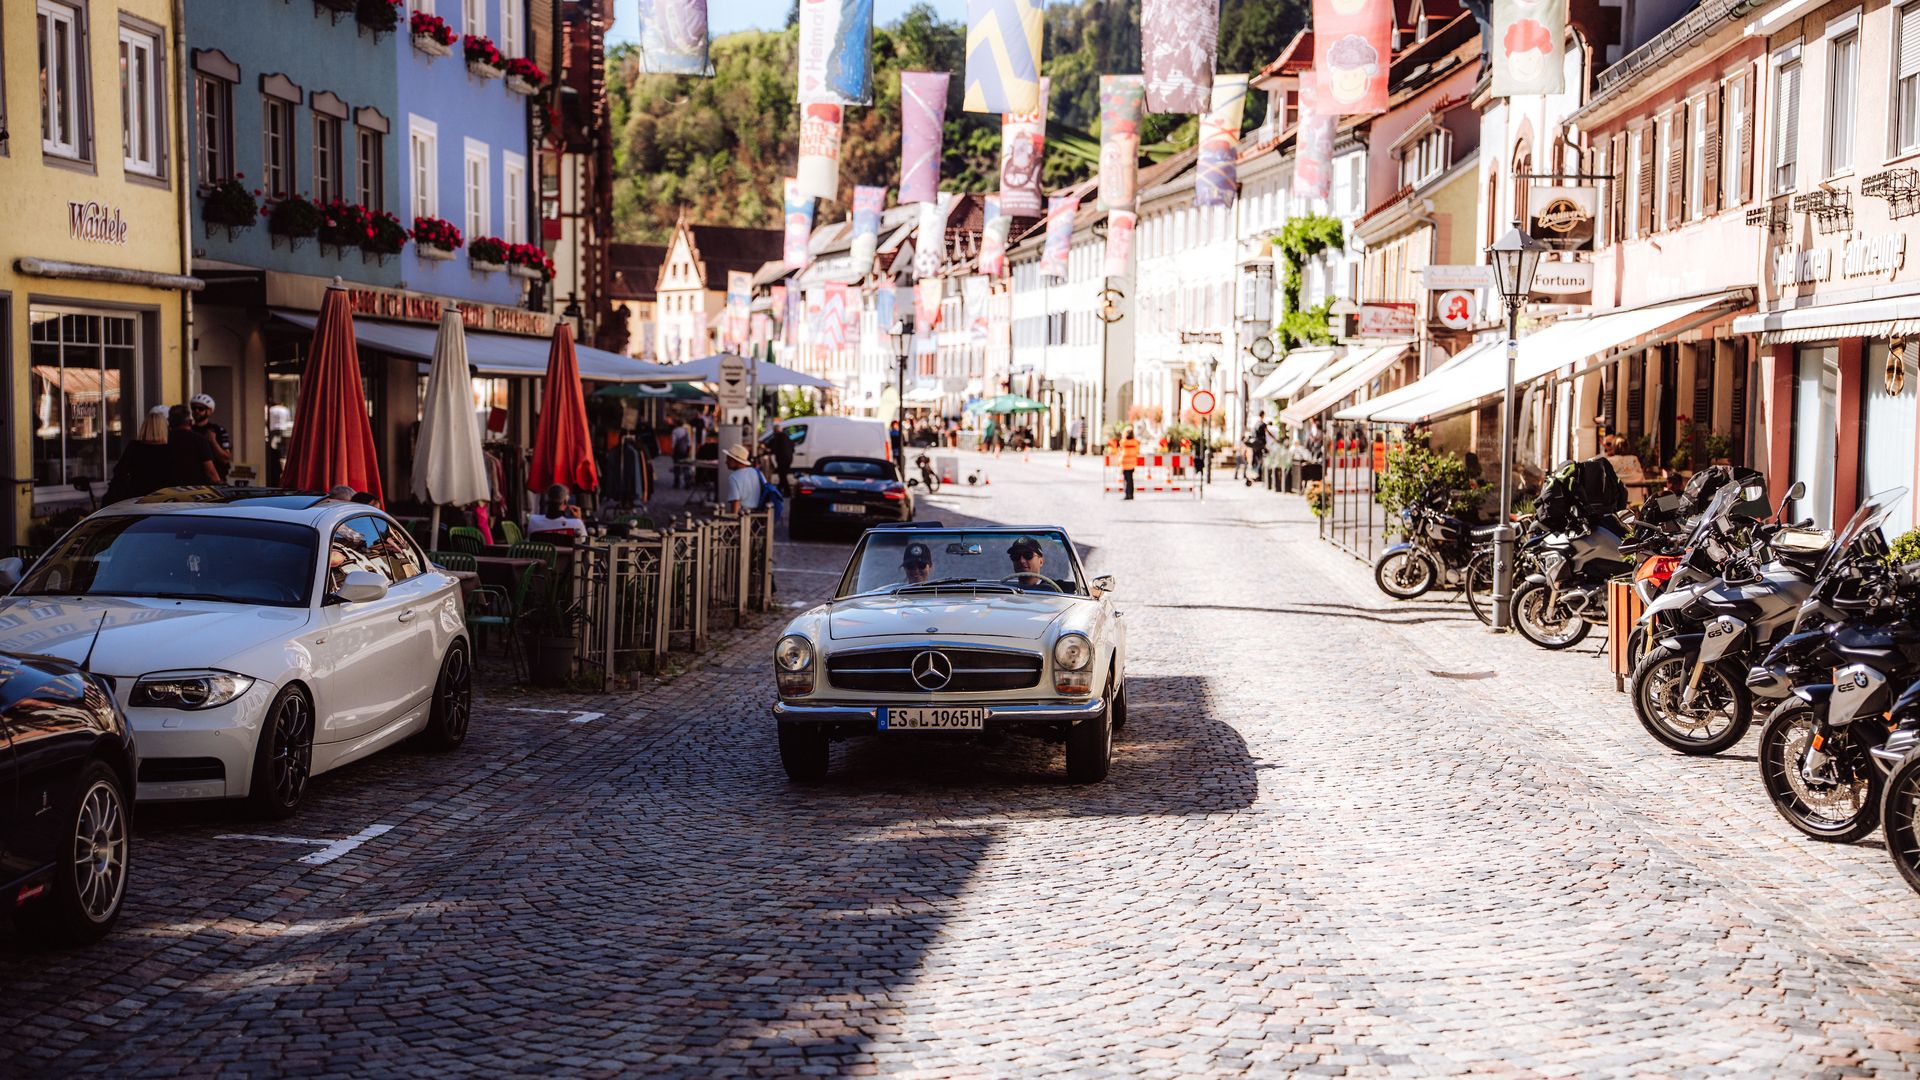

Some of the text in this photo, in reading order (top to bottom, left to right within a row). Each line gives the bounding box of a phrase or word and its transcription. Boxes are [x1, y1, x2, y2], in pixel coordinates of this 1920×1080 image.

[805, 8, 825, 71] Heimat
[68, 201, 127, 243] Waidele
[1841, 231, 1907, 282] Fahrzeuge
[1535, 275, 1585, 286] Fortuna
[1708, 629, 1722, 638] GS
[1838, 682, 1855, 693] GS
[888, 710, 908, 727] ES
